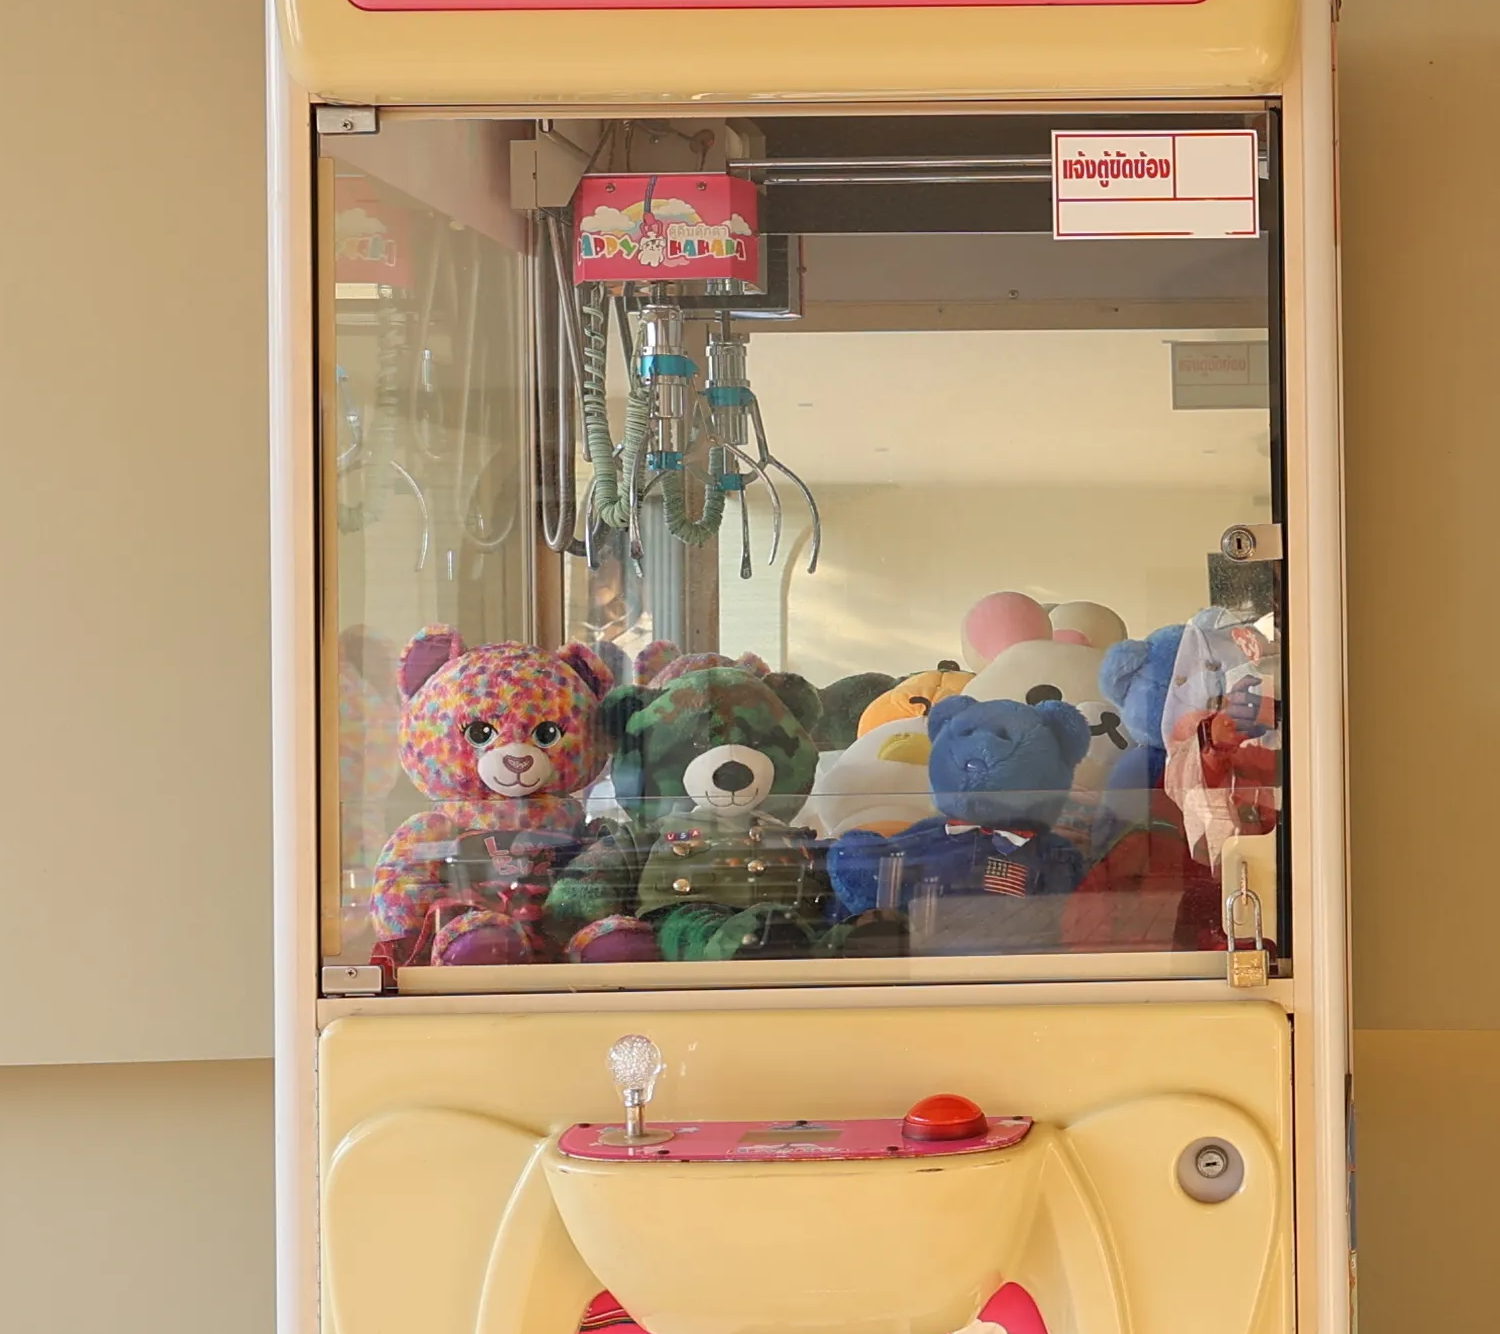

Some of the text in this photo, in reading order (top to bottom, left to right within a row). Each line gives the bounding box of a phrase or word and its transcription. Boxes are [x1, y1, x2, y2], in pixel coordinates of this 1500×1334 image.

[1062, 151, 1171, 188] แจ้งตู้ขัดข้อง
[578, 233, 637, 261] APPY
